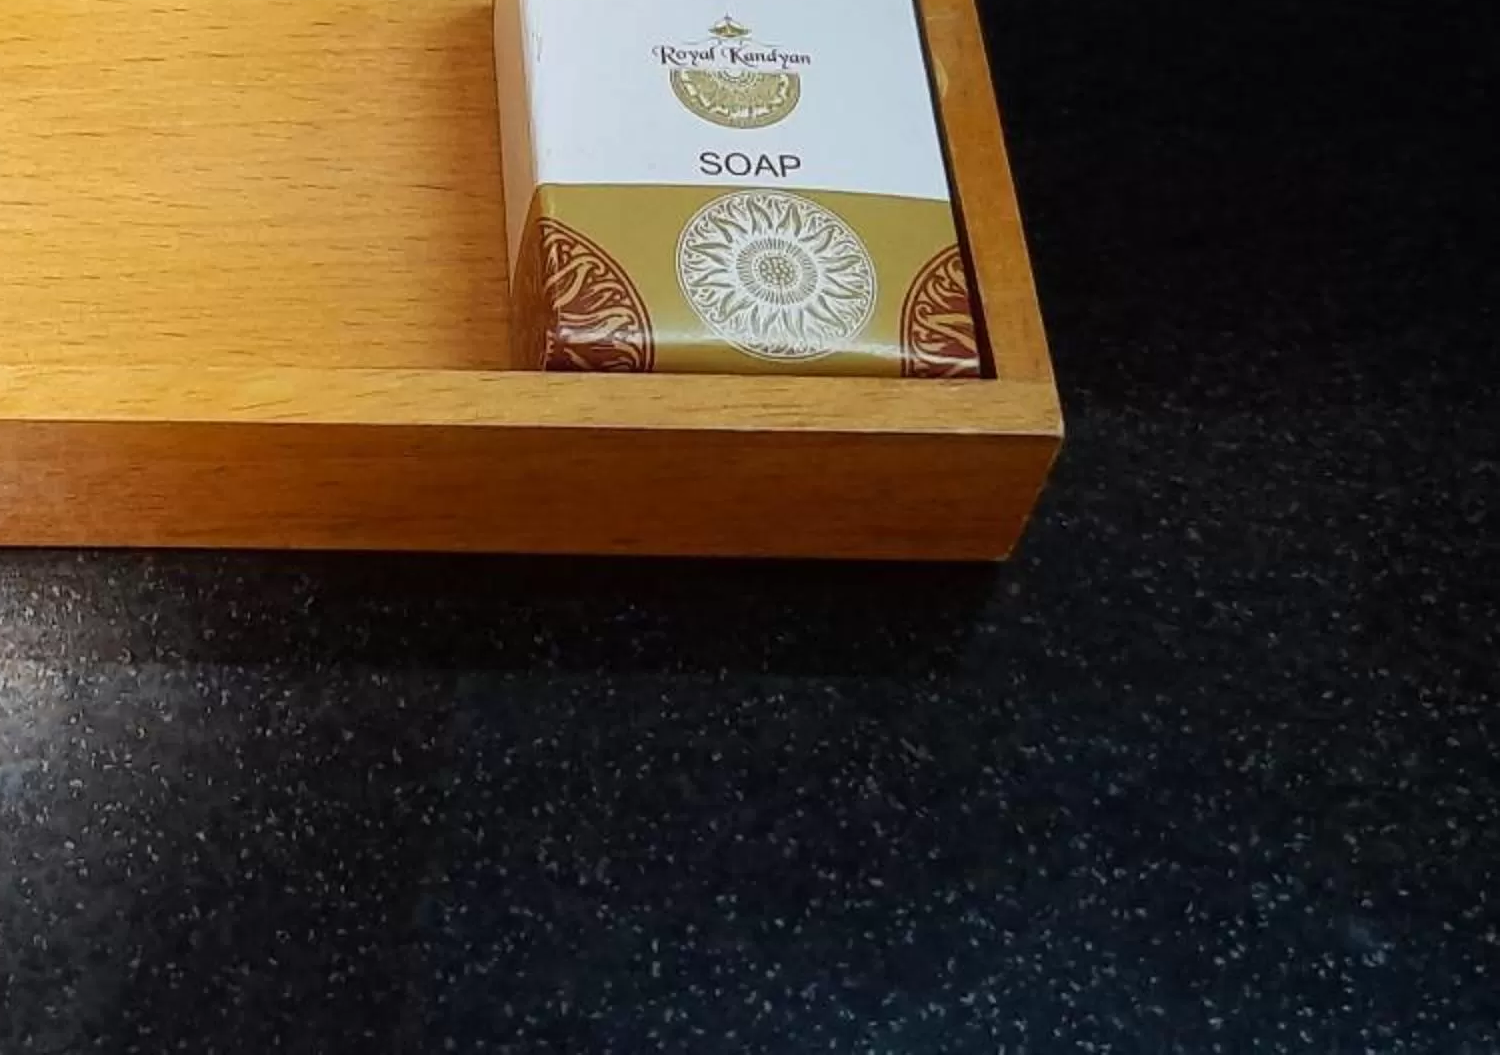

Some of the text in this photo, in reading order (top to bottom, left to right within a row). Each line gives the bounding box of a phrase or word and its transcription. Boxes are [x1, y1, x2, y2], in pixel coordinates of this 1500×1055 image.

[652, 45, 812, 70] Royal Kandyan
[699, 151, 802, 178] SOAP
